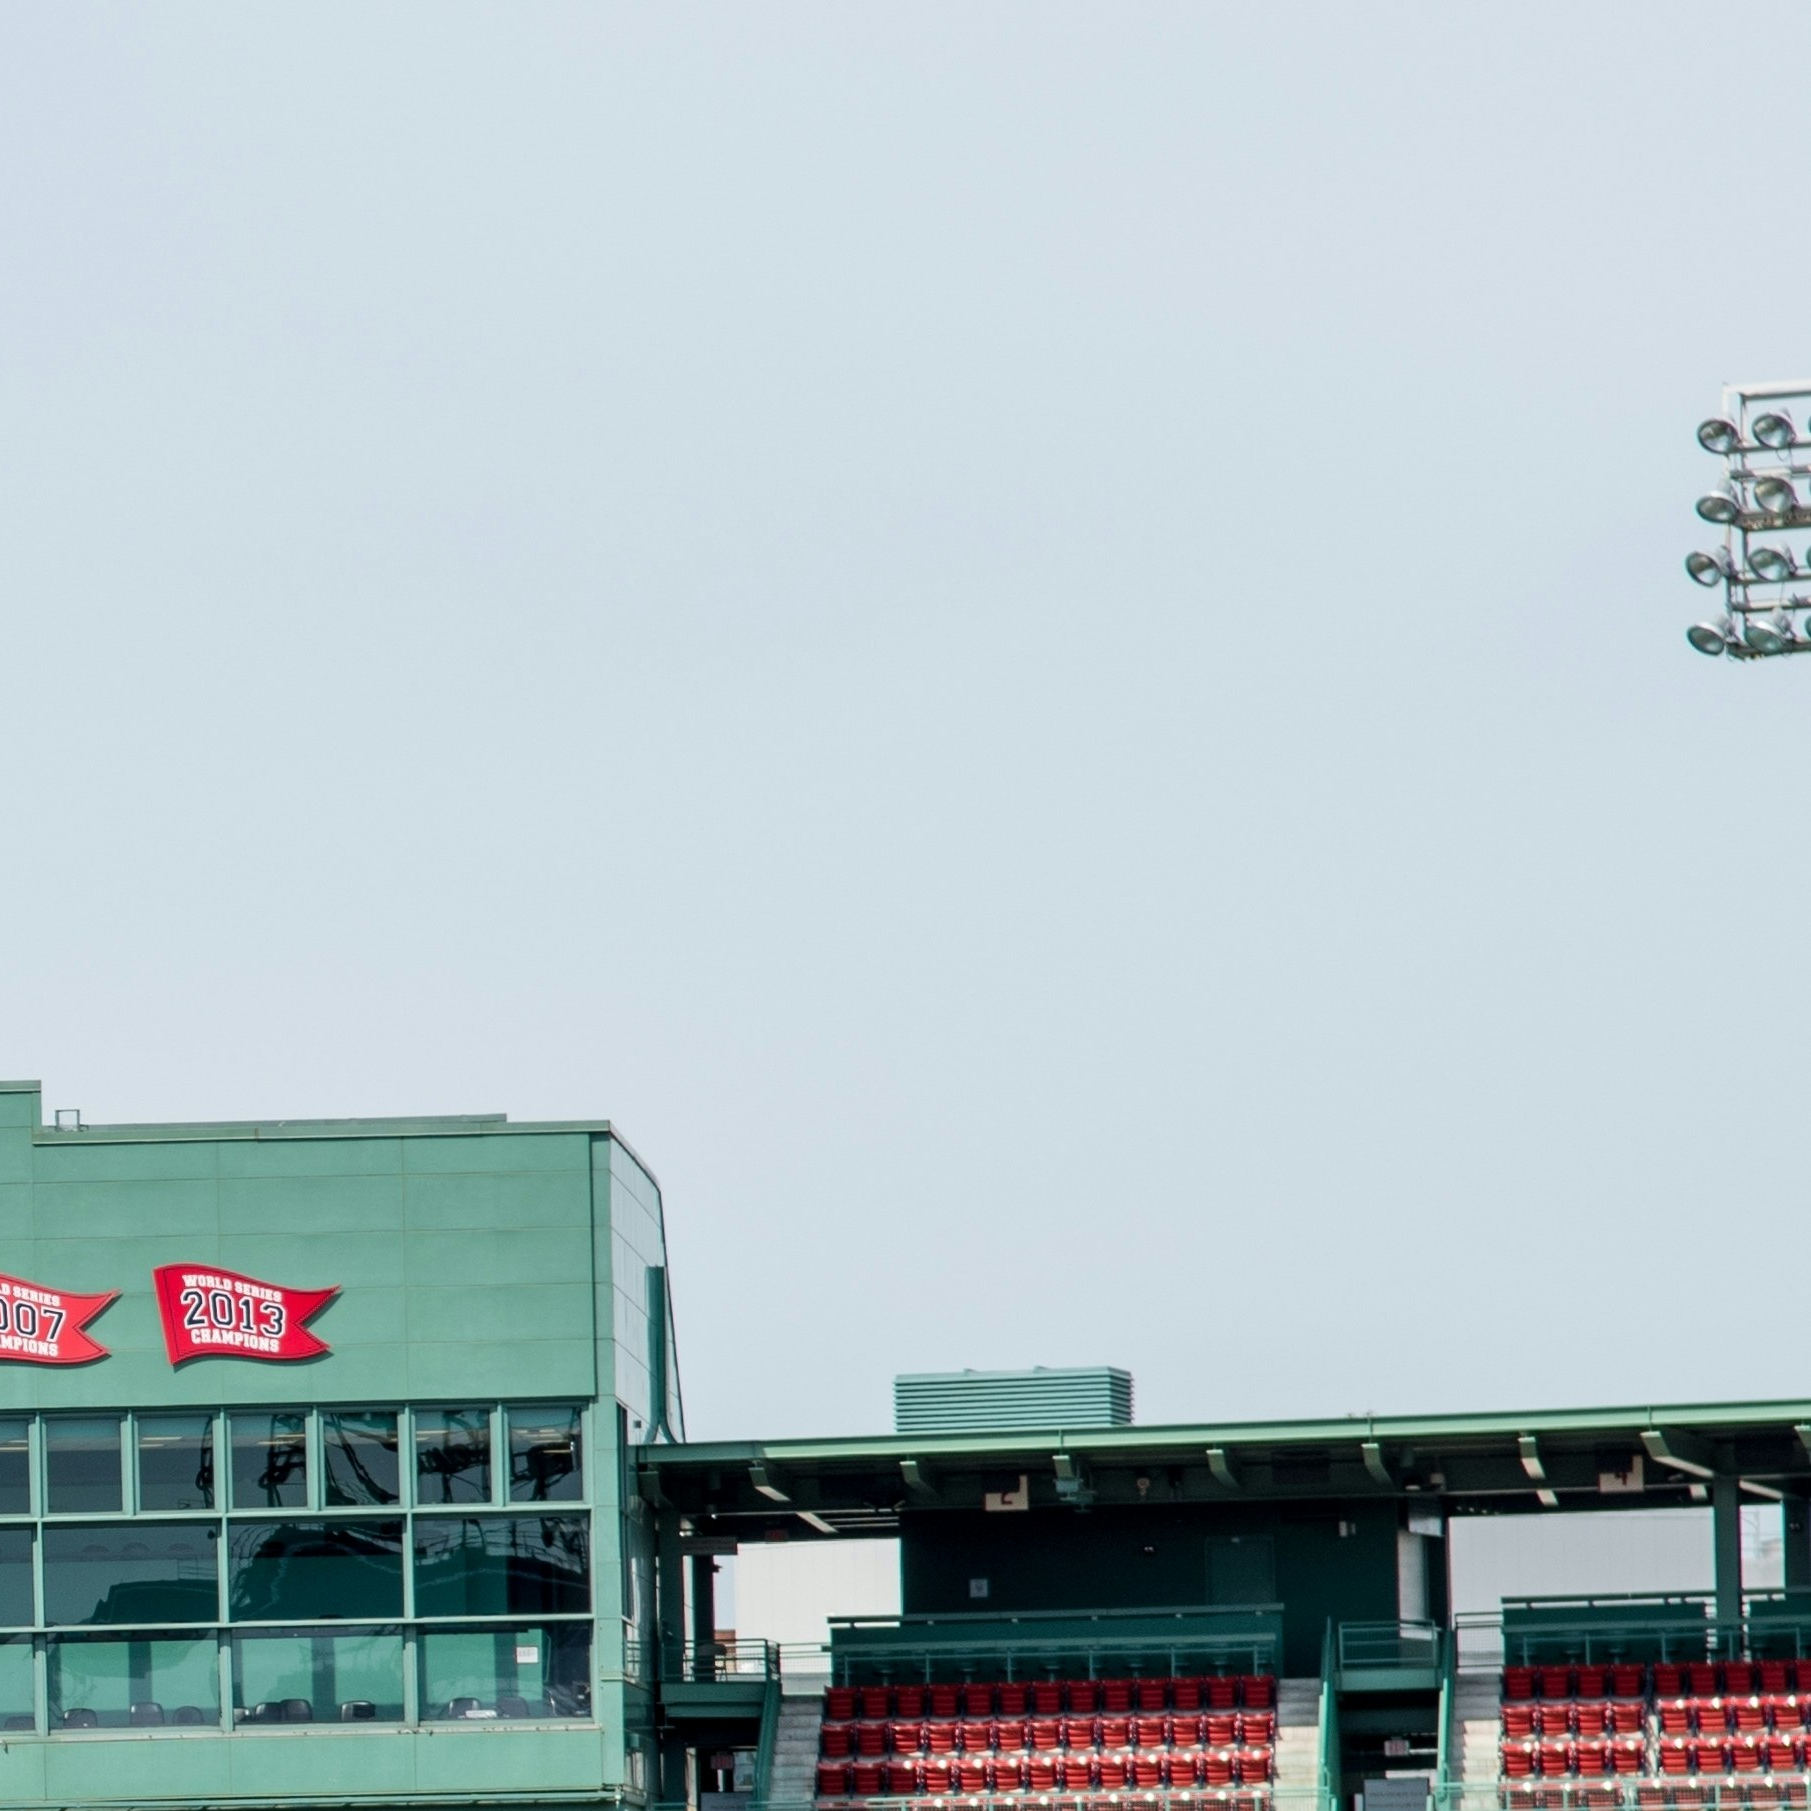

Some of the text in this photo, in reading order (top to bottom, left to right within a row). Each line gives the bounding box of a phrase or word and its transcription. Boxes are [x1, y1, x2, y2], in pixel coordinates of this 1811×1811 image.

[13, 1287, 60, 1307] SERIES
[181, 1275, 283, 1302] WORLD SERIES
[180, 1290, 286, 1338] 2013
[191, 1328, 279, 1353] CHAMPIONS
